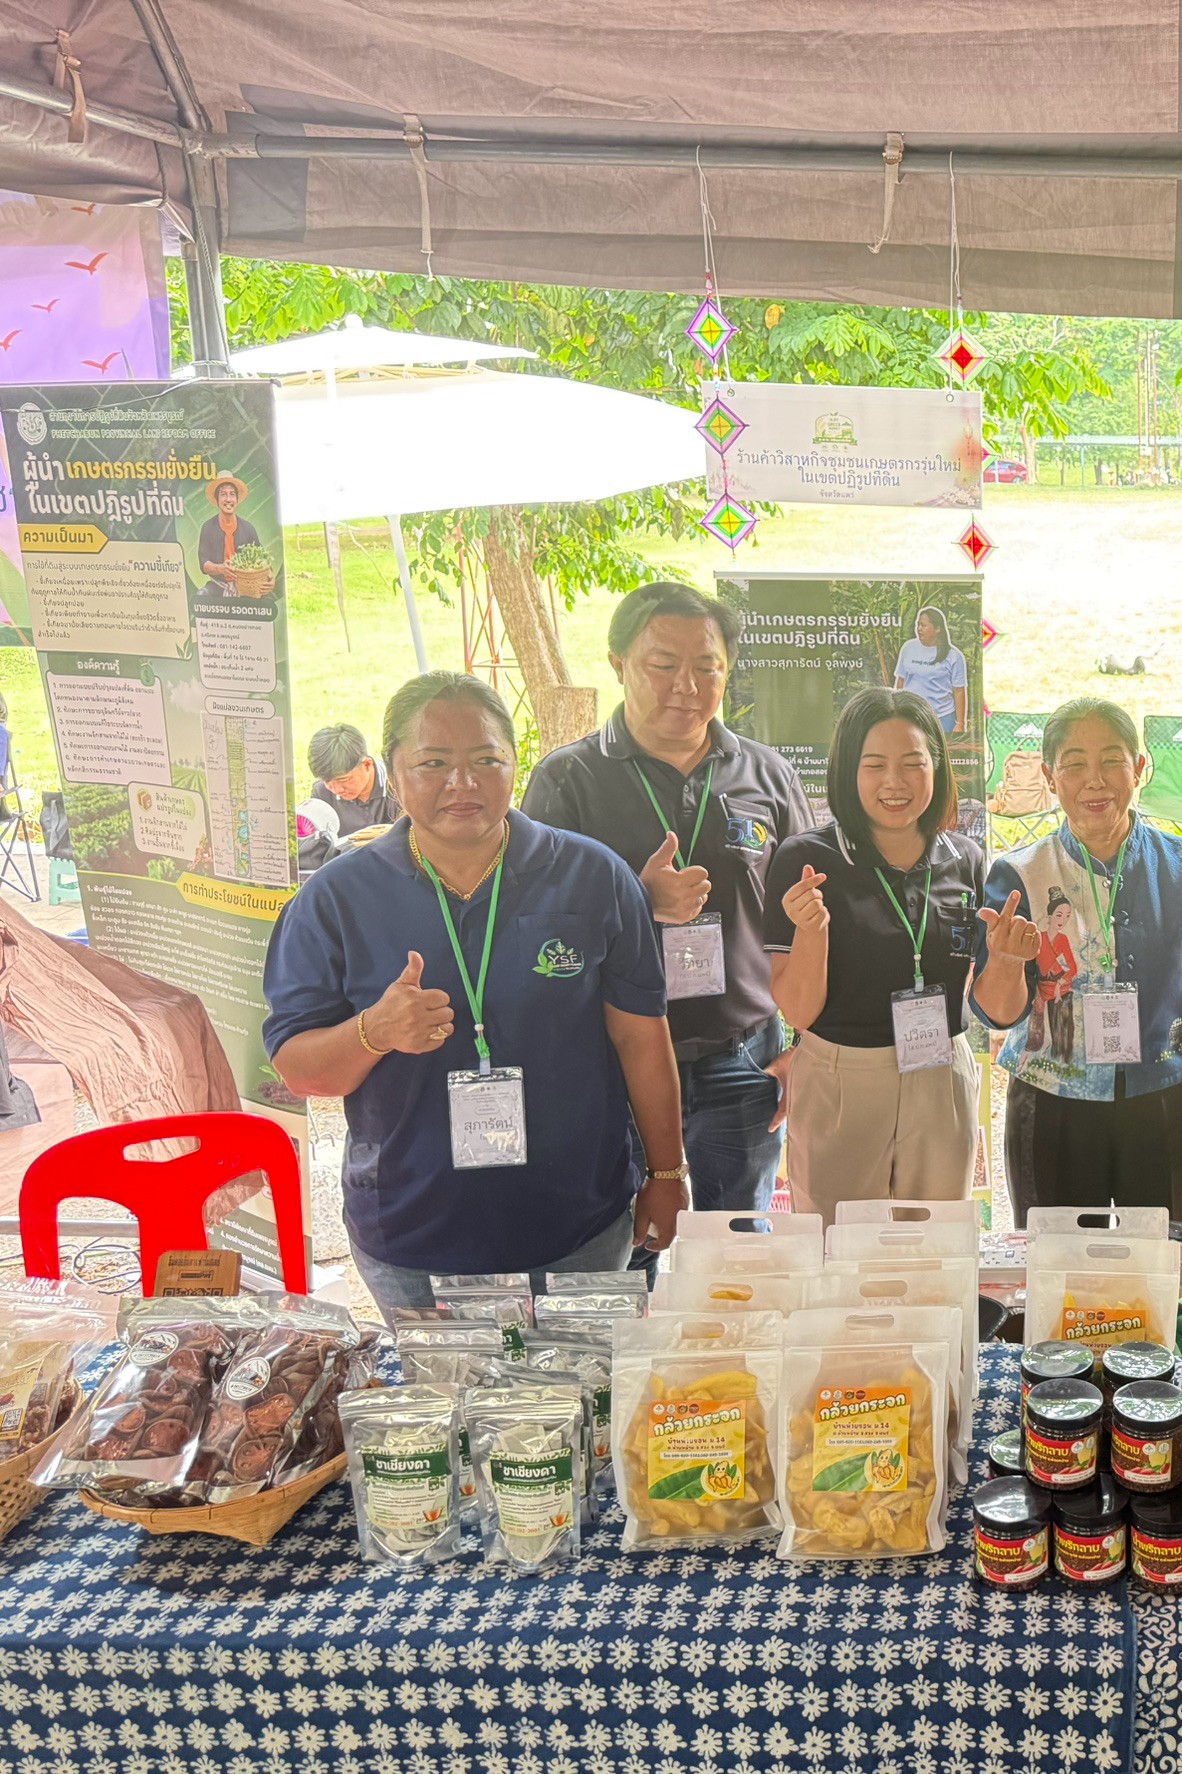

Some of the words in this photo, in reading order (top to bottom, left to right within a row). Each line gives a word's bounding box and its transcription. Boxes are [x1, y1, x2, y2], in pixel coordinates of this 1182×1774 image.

[51, 429, 100, 439] PHETCHABUN
[101, 429, 142, 439] PROVINCIAL
[143, 429, 160, 438] LAND
[162, 429, 188, 439] REFORM
[190, 429, 216, 439] OFFICE
[23, 451, 65, 487] ผู้นำ
[66, 449, 217, 480] เกษตรกรรมยั่งยืน
[737, 449, 961, 475] ร้านค้าวิสาหกิจชุมชนเกษตรกรรุ่นใหม่
[23, 527, 94, 545] ความเป็นมา
[77, 658, 120, 675] องค์ความรู้
[737, 656, 821, 670] นางสาวสุภารัตน์
[548, 954, 578, 965] YSF
[464, 1116, 513, 1133] สุภารัตน์
[1066, 1315, 1142, 1340] กล้วยกระจก
[820, 1392, 906, 1421] กล้วยกระจก
[653, 1407, 741, 1437] กล้วยกระจก
[376, 1458, 430, 1471] ชาเชียงดา
[503, 1465, 556, 1478] ชาเชียงดา
